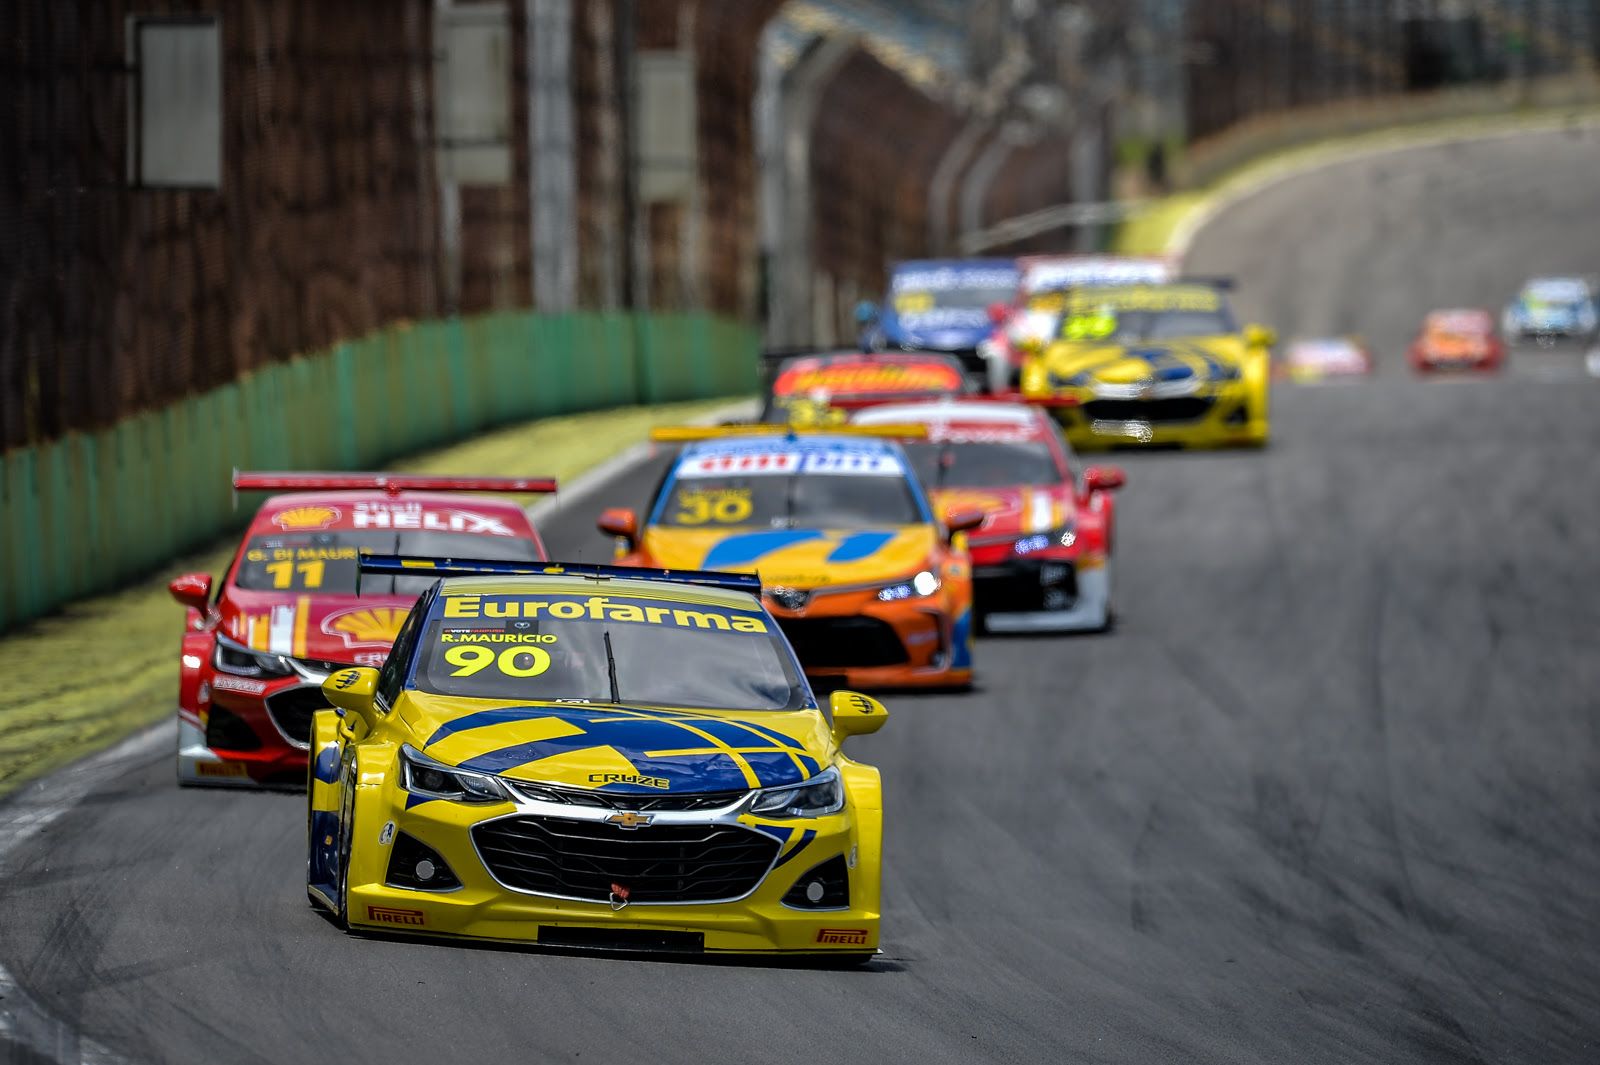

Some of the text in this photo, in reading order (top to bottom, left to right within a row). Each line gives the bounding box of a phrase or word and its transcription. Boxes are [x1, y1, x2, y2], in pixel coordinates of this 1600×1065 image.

[353, 510, 516, 537] HELIX
[676, 495, 754, 524] 30
[266, 560, 325, 589] 11
[443, 596, 768, 633] Eurofarma
[444, 645, 551, 677] 90
[588, 773, 670, 790] CRUZE
[368, 906, 424, 925] PIRELLI
[816, 929, 868, 944] PIRELLI
